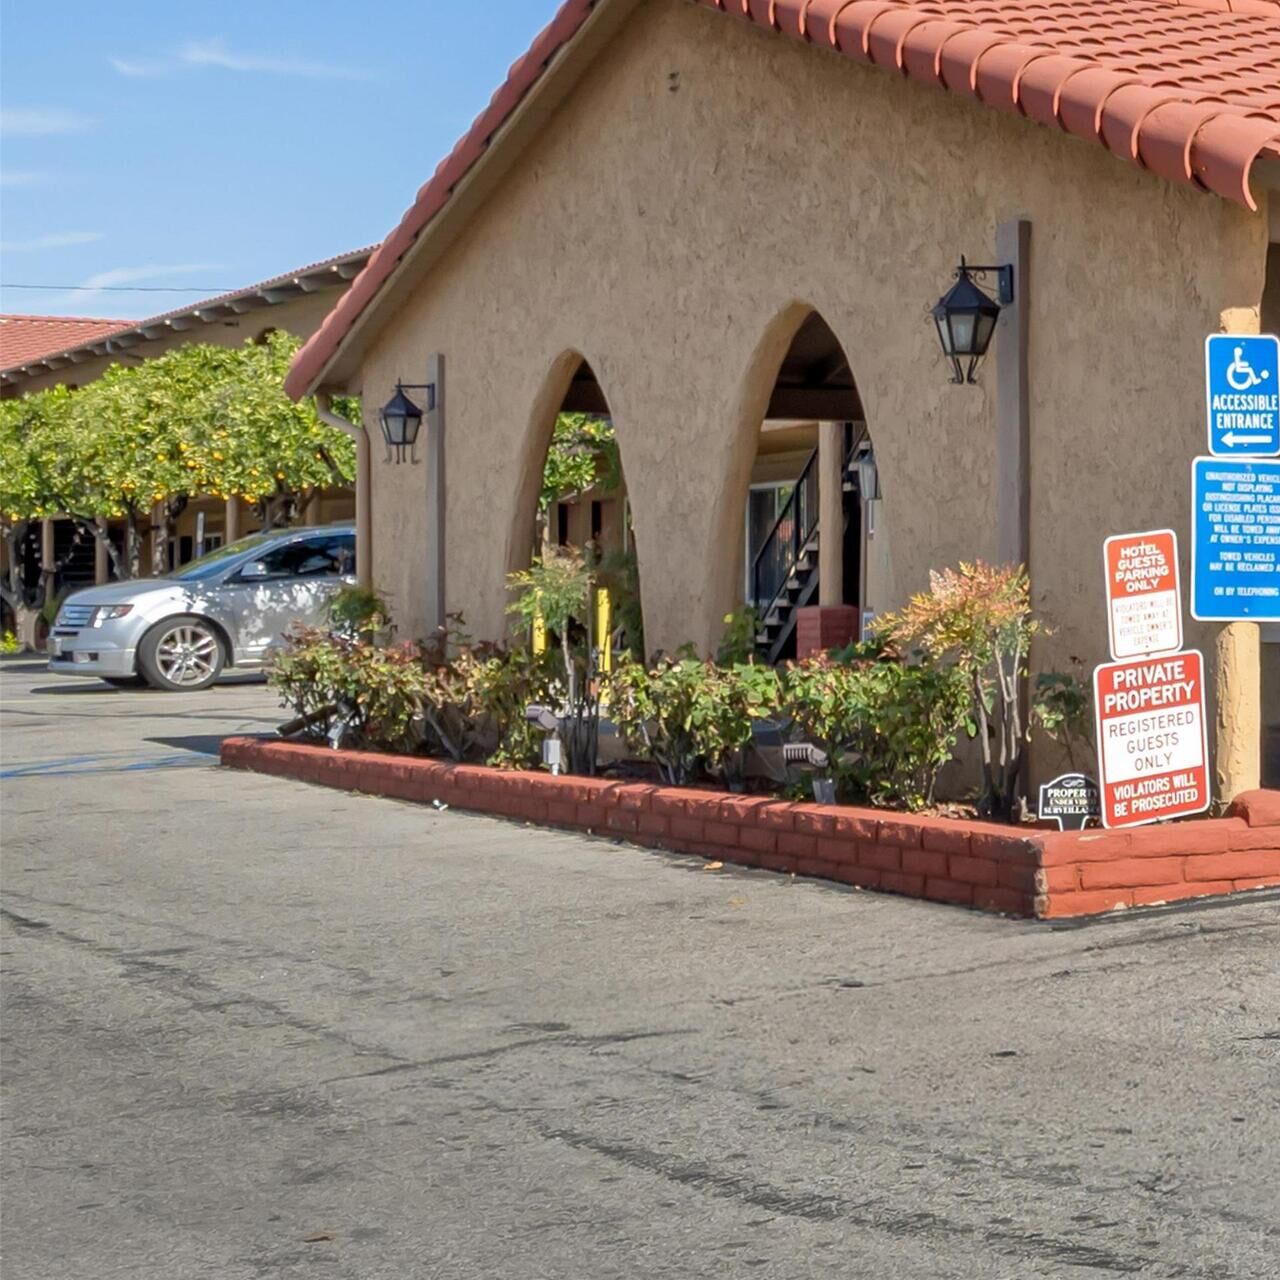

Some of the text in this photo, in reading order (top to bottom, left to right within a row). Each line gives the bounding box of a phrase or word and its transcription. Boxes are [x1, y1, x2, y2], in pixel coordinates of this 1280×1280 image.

[1212, 394, 1278, 411] ACCESSIBLE
[1216, 412, 1274, 429] ENTRANCE
[1205, 472, 1256, 482] UNAUTHORIZED
[1222, 482, 1273, 493] NOT DISPLAYING
[1202, 502, 1213, 512] OR
[1214, 503, 1241, 512] LICENSE
[1244, 504, 1267, 514] PLATES
[1208, 513, 1222, 522] FOR
[1224, 514, 1255, 523] DISABLED
[1214, 524, 1280, 534] WILL BE TOWED AWAY
[1210, 534, 1218, 543] AT
[1220, 534, 1251, 544] OWNER'S
[1121, 544, 1160, 558] HOTEL
[1220, 552, 1275, 561] TOWED VEHICLES
[1118, 554, 1165, 570] GUESTS
[1209, 562, 1222, 571] MAY
[1225, 562, 1234, 571] BE
[1237, 562, 1274, 572] RECLAIMED
[1115, 566, 1169, 583] PARKING
[1126, 578, 1160, 592] ONLY
[1214, 586, 1279, 596] OR BY TELEPHONING
[1113, 660, 1185, 690] PRIVATE
[1104, 680, 1195, 713] PROPERTY
[1109, 710, 1194, 738] REGISTERED
[1127, 732, 1179, 754] GUESTS
[1135, 752, 1173, 771] ONLY
[1048, 789, 1097, 798] PROPERTY
[1113, 773, 1197, 800] VIOLATORS WILL
[1114, 788, 1198, 817] BE PROSECUTED
